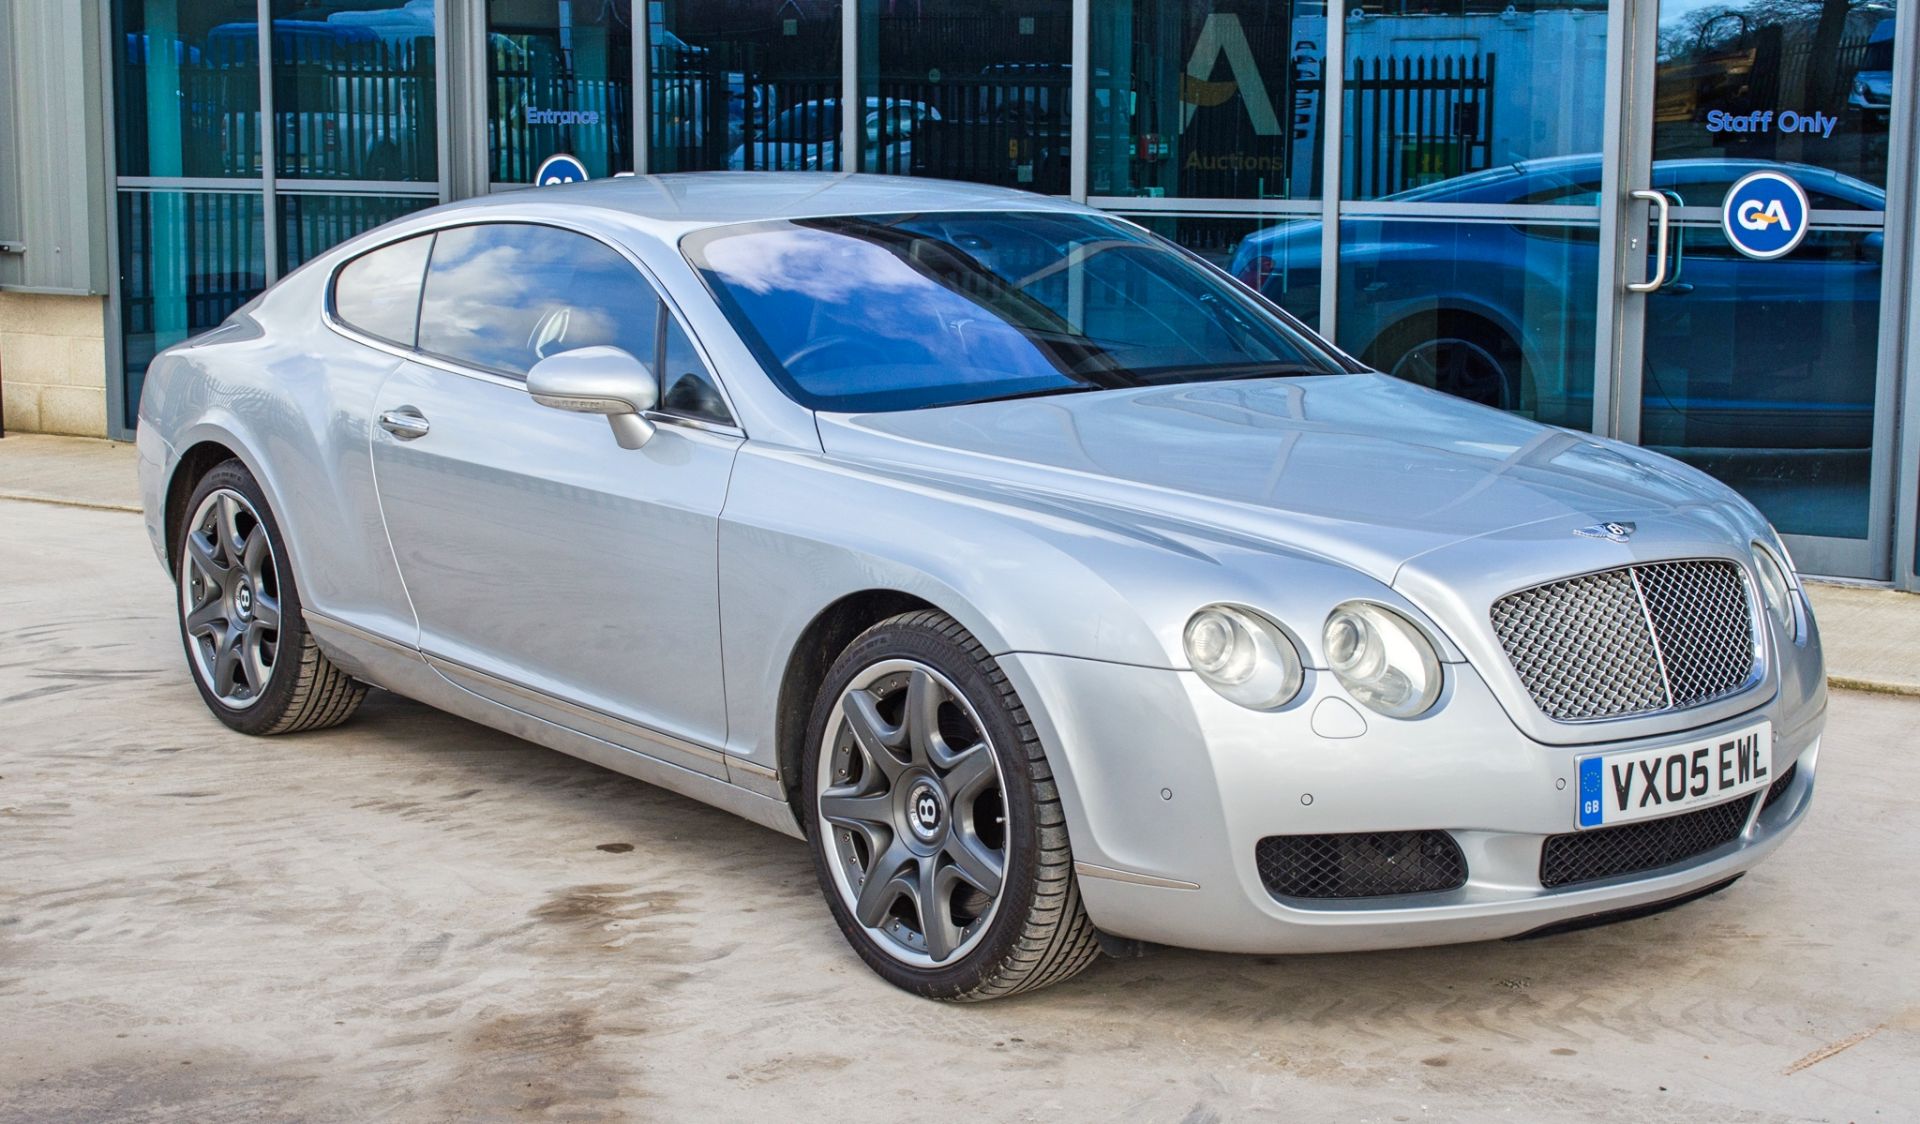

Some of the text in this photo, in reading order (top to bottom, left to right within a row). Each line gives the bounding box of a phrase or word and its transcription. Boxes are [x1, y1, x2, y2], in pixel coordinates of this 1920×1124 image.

[526, 106, 599, 126] Entrance
[1706, 109, 1838, 139] Staff Only
[1185, 150, 1283, 171] Auctions
[1737, 199, 1792, 232] GA
[1611, 733, 1768, 812] VX05 EWL
[1584, 799, 1600, 815] GB
